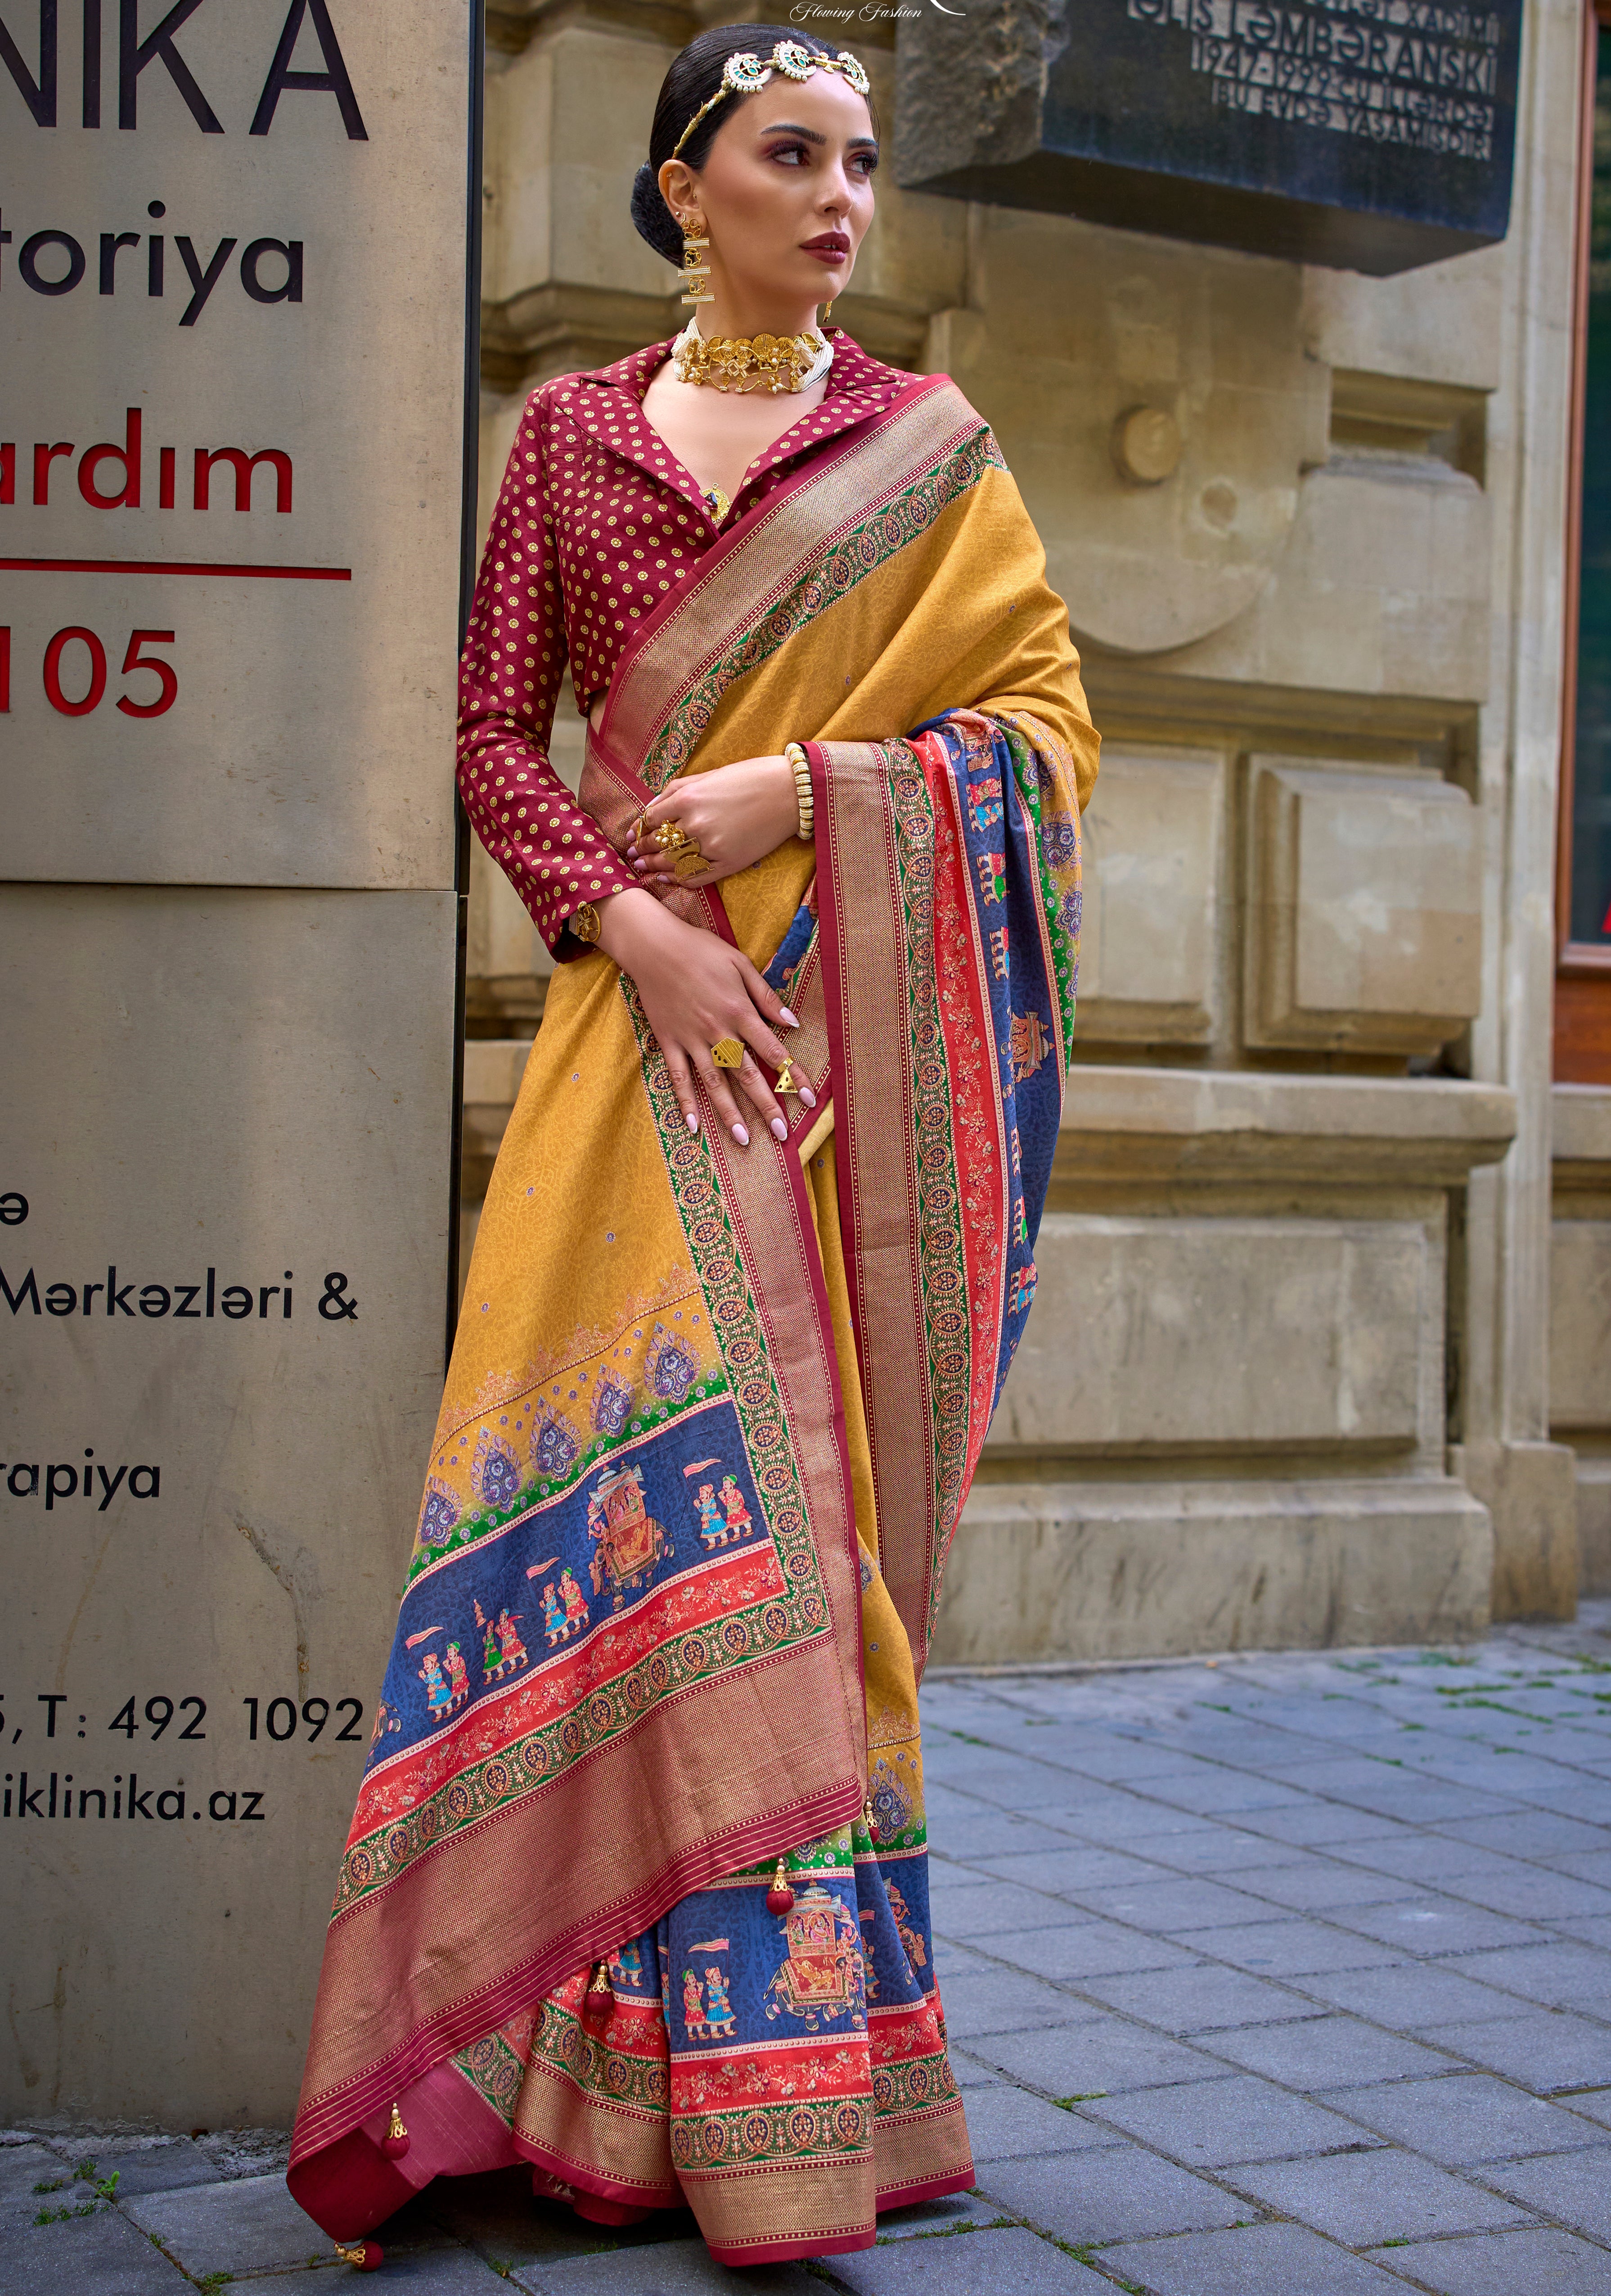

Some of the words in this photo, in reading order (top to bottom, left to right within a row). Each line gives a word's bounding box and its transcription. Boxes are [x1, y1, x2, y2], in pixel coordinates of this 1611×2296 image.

[0, 200, 303, 326] oriya
[0, 408, 293, 513] rdım
[0, 1266, 293, 1319] Mərkəzləri
[318, 1272, 358, 1320] &
[0, 1448, 160, 1511] apiya
[108, 1695, 207, 1741] 492
[243, 1697, 364, 1743] 1092
[3, 1772, 265, 1821] iklinika.az
